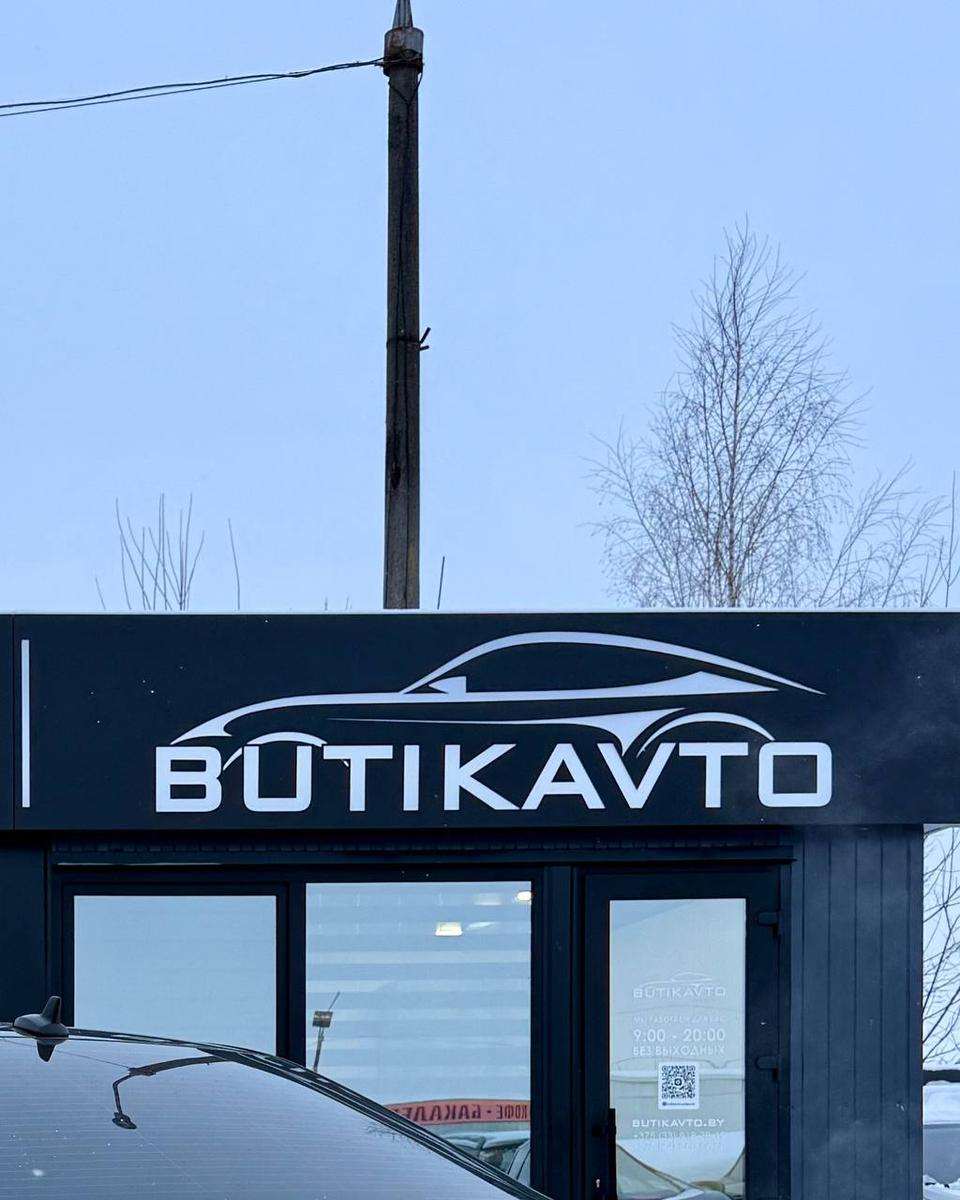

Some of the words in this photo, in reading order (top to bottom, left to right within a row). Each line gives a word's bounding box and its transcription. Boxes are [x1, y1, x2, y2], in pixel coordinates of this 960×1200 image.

[155, 740, 834, 813] BUTIKAVTO
[633, 986, 726, 999] BUTIKAVTO
[633, 1028, 666, 1042] 9:00
[683, 1027, 726, 1042] 20:00
[633, 1046, 652, 1056] БЕЗ
[655, 1045, 725, 1056] ВЫХОДНЫХ
